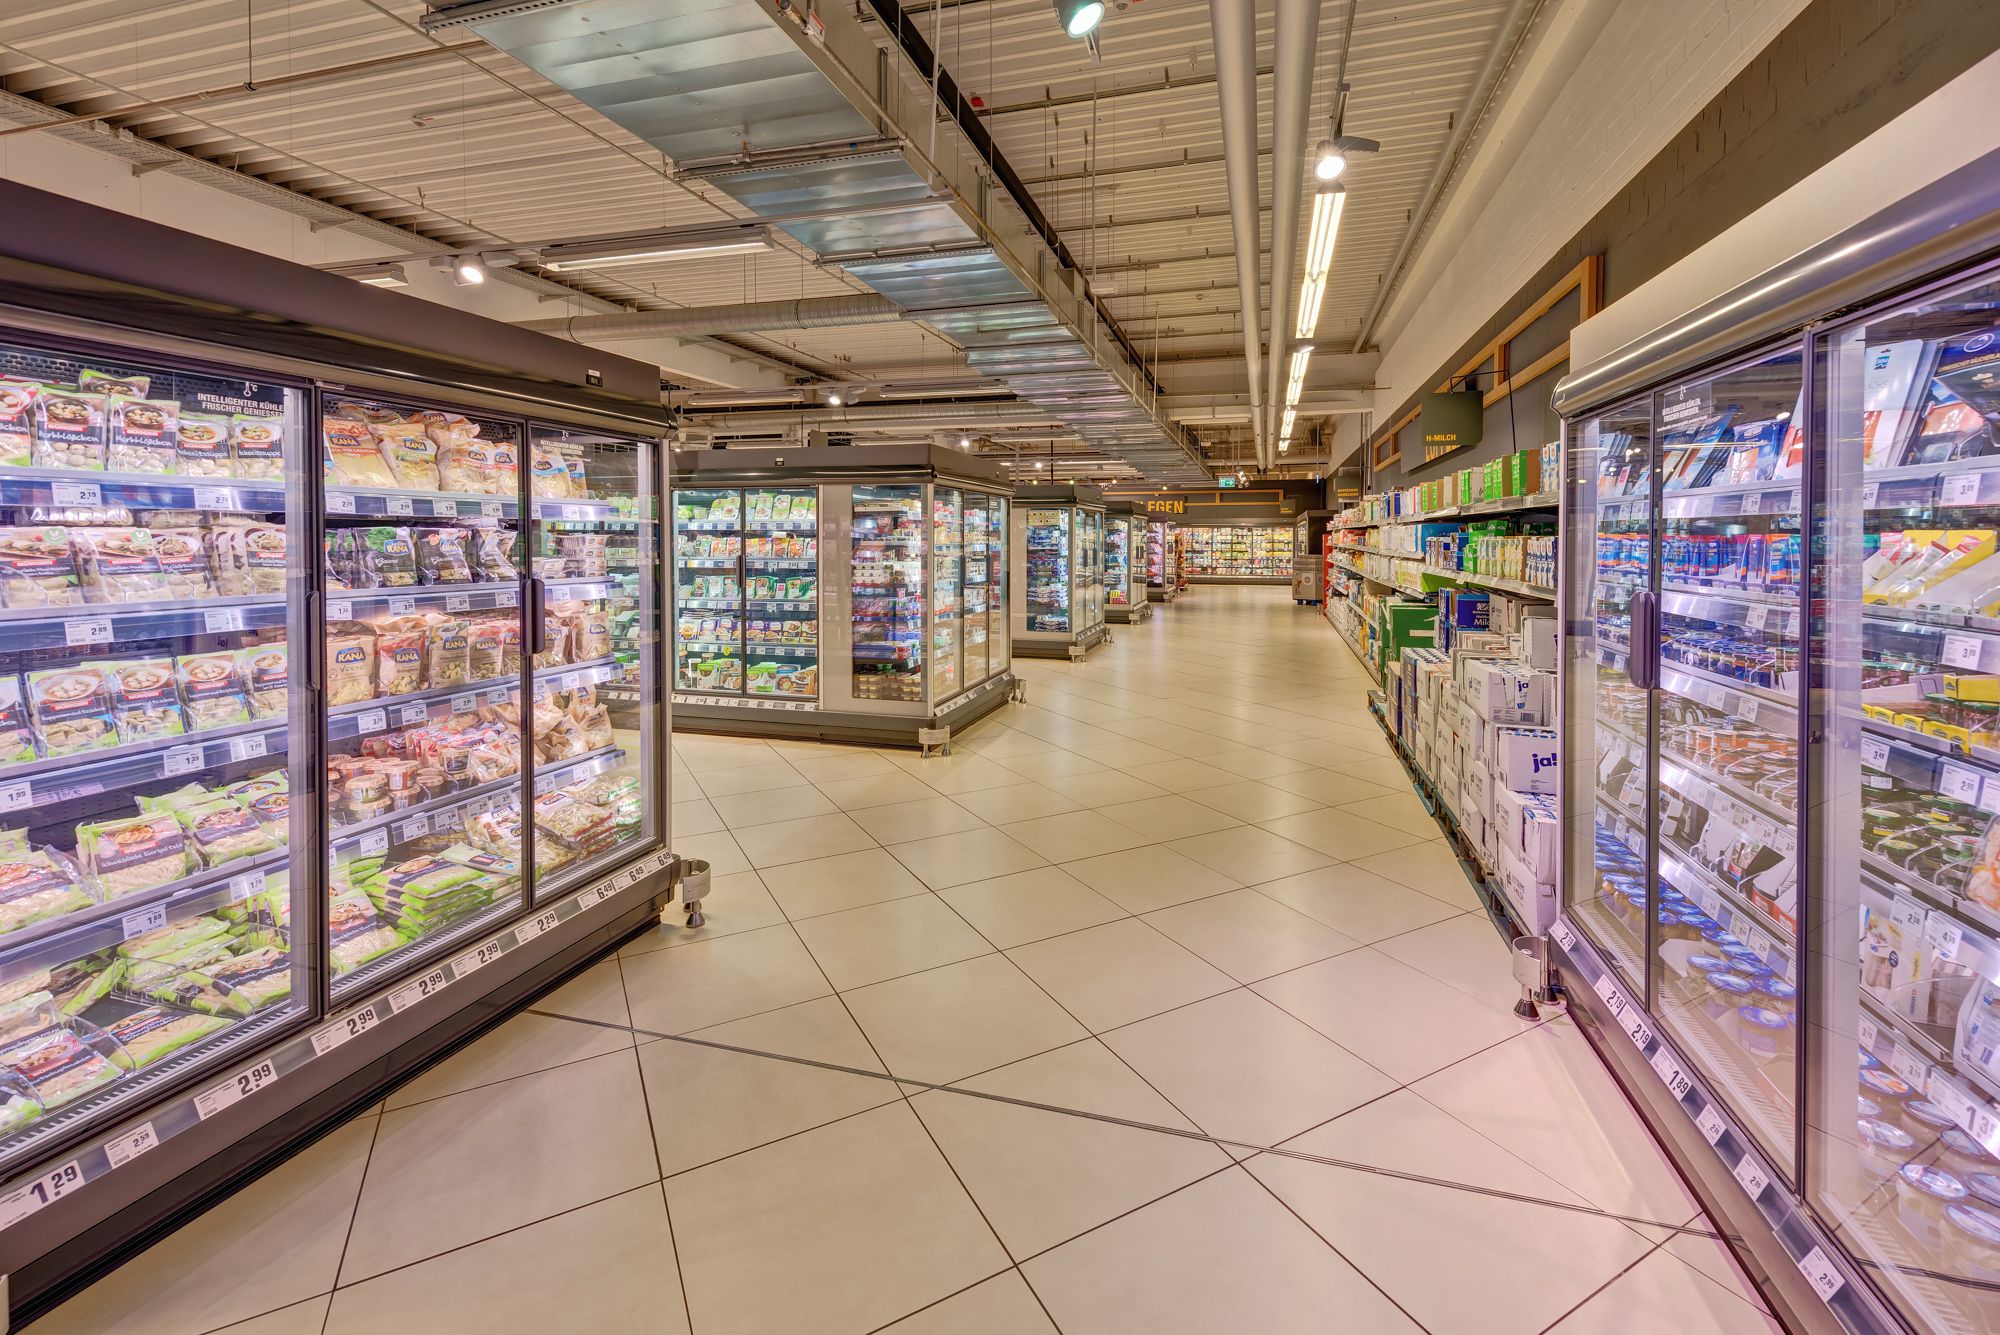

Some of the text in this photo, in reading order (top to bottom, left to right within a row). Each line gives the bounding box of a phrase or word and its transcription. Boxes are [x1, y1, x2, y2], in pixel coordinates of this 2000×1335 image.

[197, 392, 258, 408] INTELLIGENTER
[202, 401, 242, 414] FRISCHER
[1426, 434, 1456, 442] H-MILCH
[1532, 752, 1557, 773] ja!
[657, 851, 671, 866] 6.49
[629, 866, 644, 882] 6.49
[596, 882, 613, 900] 6.49
[537, 913, 556, 932] 2.29
[1560, 931, 1574, 948] 2.19
[477, 942, 500, 965] 2.99
[419, 971, 444, 996] 2.99
[1607, 990, 1623, 1010] 2.19
[347, 1008, 375, 1036] 2.99
[1631, 1024, 1651, 1045] 2.19
[237, 1063, 273, 1096] 2.99
[1669, 1070, 1689, 1094] 1.89
[133, 1132, 150, 1148] 2.59
[30, 1165, 78, 1204] 1.29
[1819, 1273, 1835, 1290] 2.99
